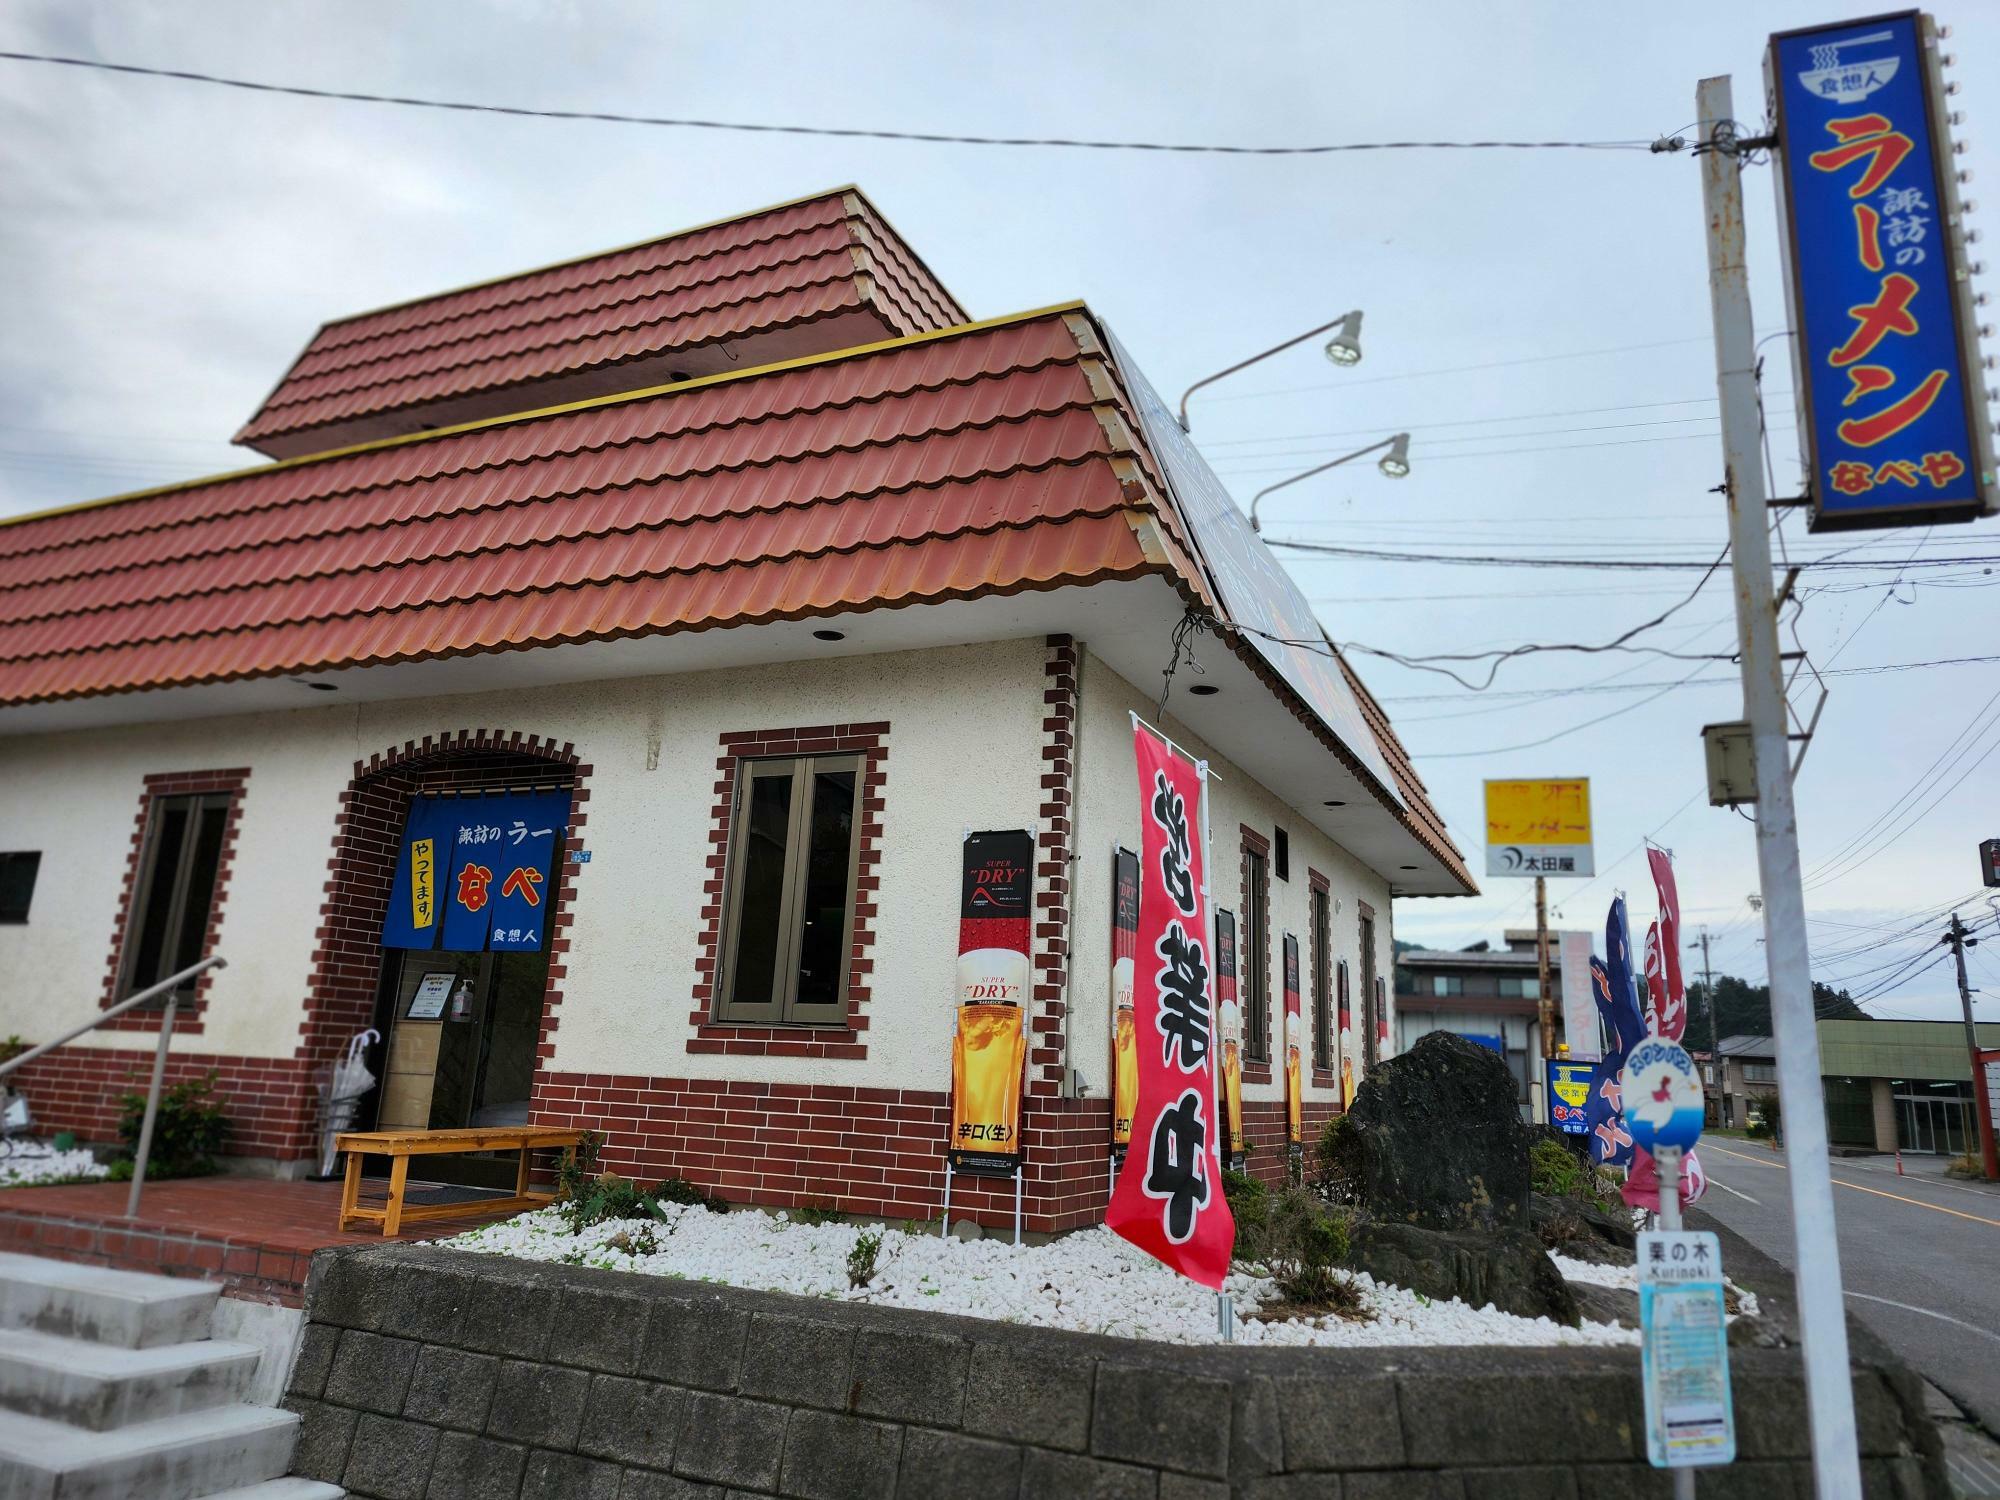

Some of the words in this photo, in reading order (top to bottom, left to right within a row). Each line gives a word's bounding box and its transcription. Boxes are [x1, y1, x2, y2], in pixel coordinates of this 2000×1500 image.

[1819, 71, 1884, 95] 食想人
[1879, 187, 1931, 266] 諏訪の
[1809, 113, 1949, 447] ラーメン
[1828, 451, 1965, 495] なべや
[985, 859, 1012, 867] SUPER
[1524, 857, 1575, 872] 太田屋
[457, 862, 543, 912] なべ
[492, 928, 538, 943] 食想人
[1553, 1104, 1588, 1121] なべ
[1650, 1265, 1711, 1280] Kurinoki
